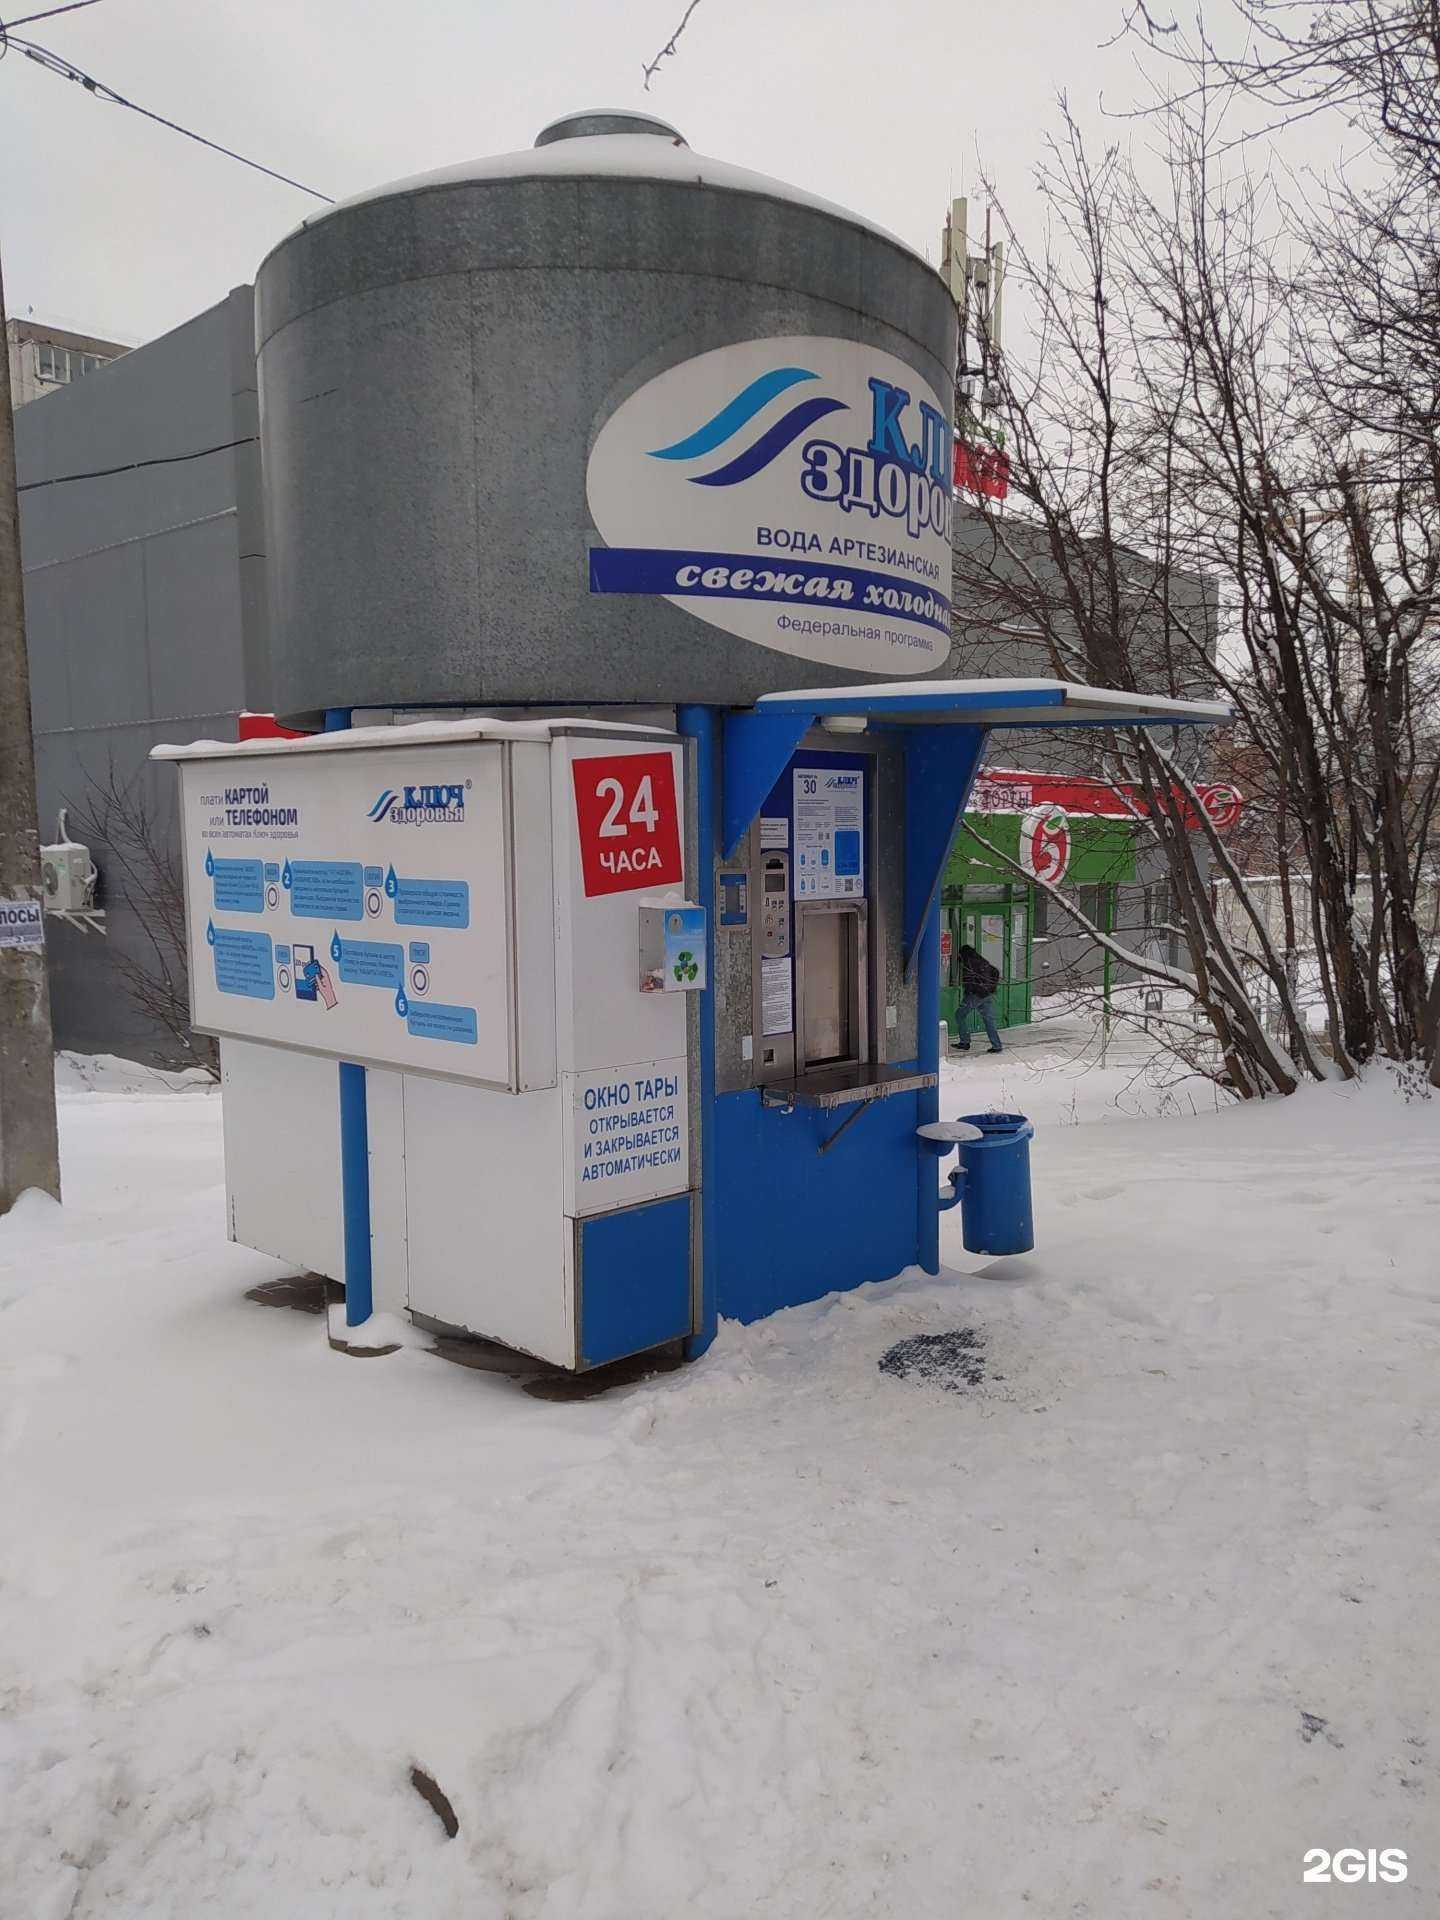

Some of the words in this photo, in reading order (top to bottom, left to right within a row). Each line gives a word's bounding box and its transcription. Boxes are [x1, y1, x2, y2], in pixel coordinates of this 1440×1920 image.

[757, 527, 822, 553] ВОДА
[829, 537, 940, 581] АРТЕЗИАНСКАЯ
[675, 564, 854, 600] свежая
[777, 615, 881, 640] Федеральная
[225, 782, 269, 805] КАРТОЙ
[403, 785, 465, 808] КЛЮЧ
[803, 780, 817, 794] 30
[225, 808, 298, 826] ТЕЛЕФОНОМ
[596, 775, 659, 837] 24
[600, 846, 663, 874] ЧАСА
[284, 874, 290, 885] 2
[388, 880, 395, 893] 3
[333, 945, 339, 957] 5
[584, 1083, 630, 1110] ОКНО
[635, 1076, 678, 1101] ТАРЫ
[589, 1105, 674, 1134] ОТКРЫВАЕТСЯ
[584, 1143, 592, 1158] И
[596, 1126, 679, 1156] ЗАКРЫВАЕТСЯ
[582, 1147, 680, 1181] АВТОМАТИЧЕСКИ
